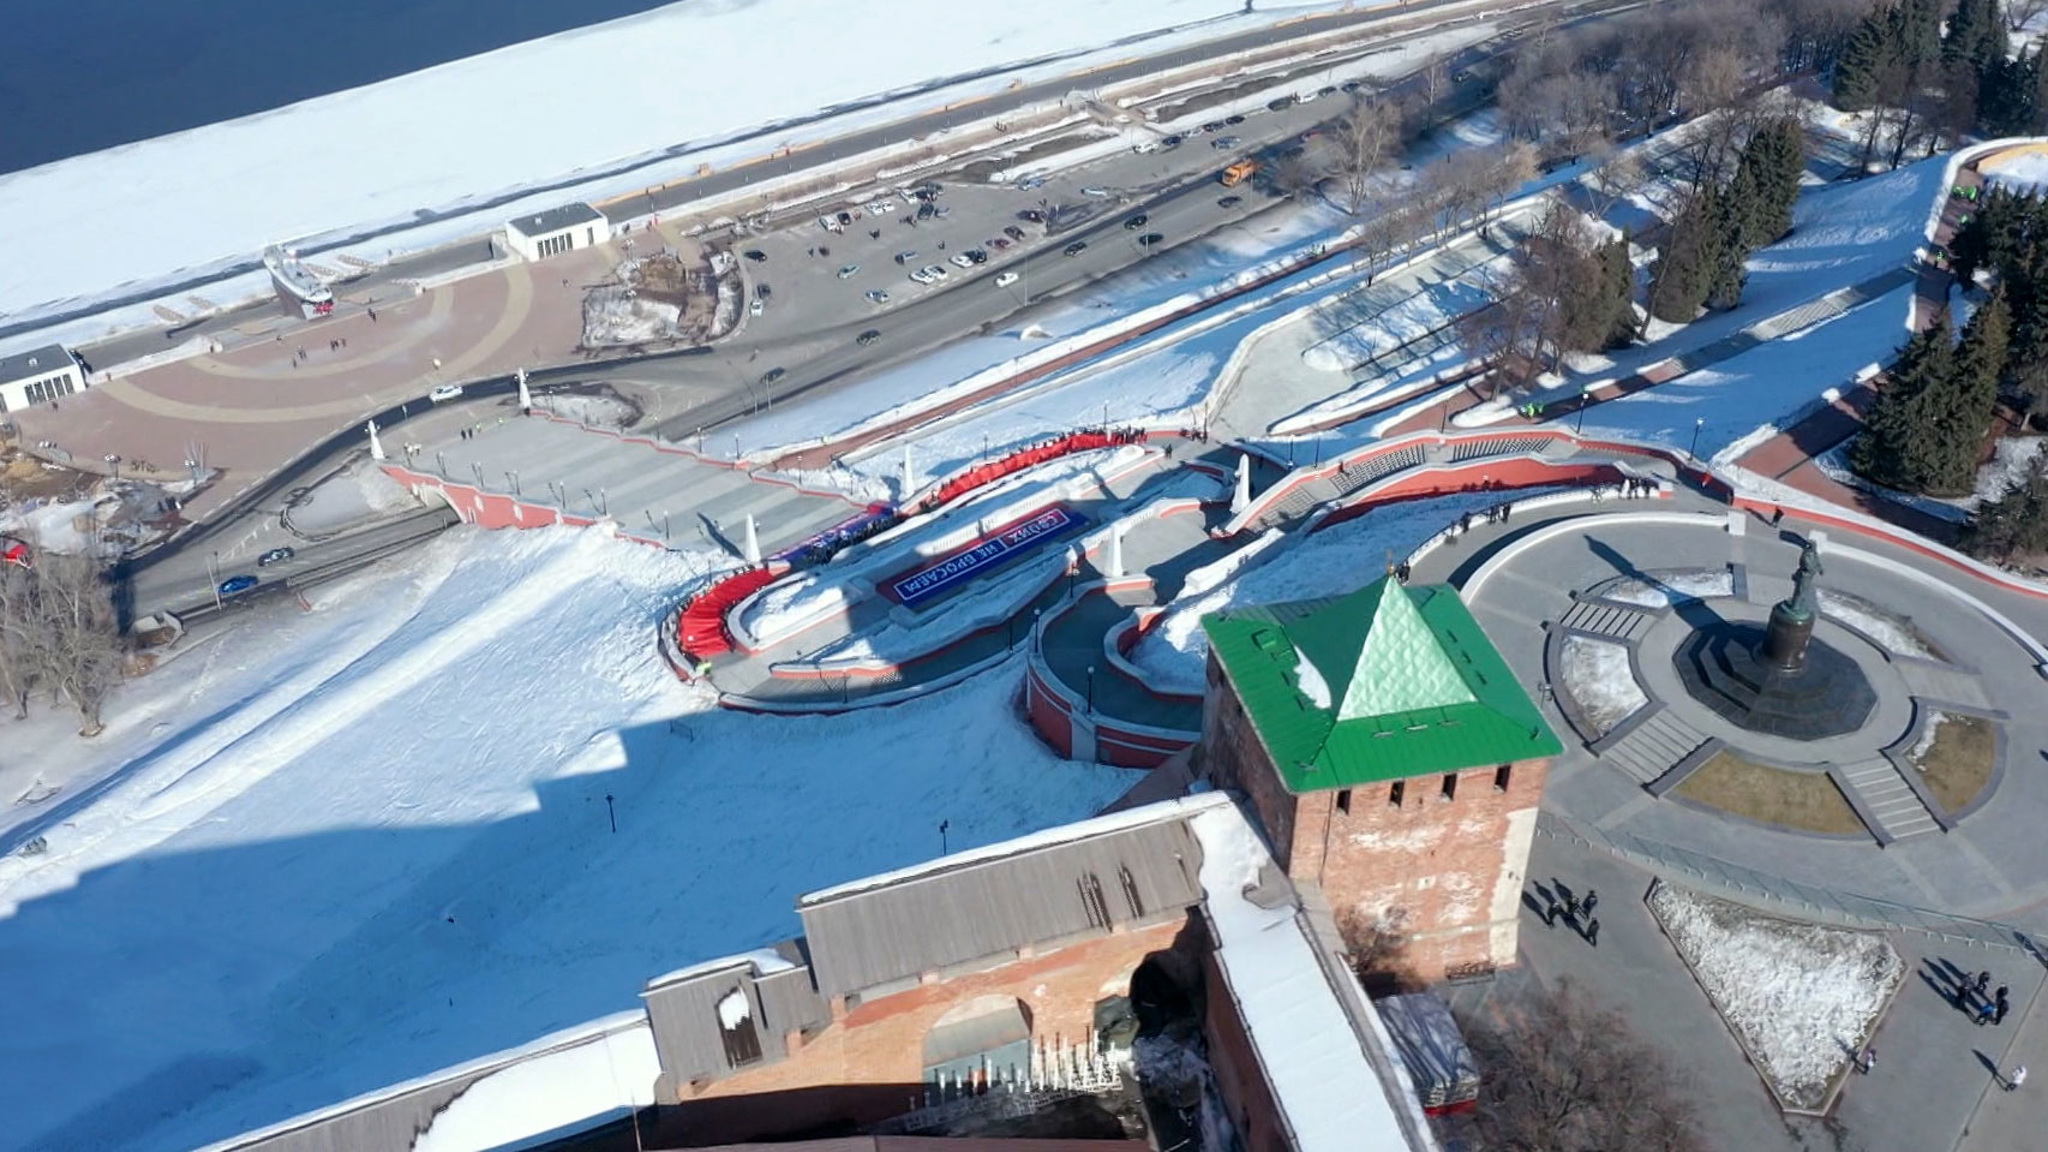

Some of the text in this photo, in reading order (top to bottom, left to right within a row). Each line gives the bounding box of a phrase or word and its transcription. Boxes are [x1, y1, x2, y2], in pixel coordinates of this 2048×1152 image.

[904, 515, 1059, 593] СВОИХ НЕ БРОСАЕМ
